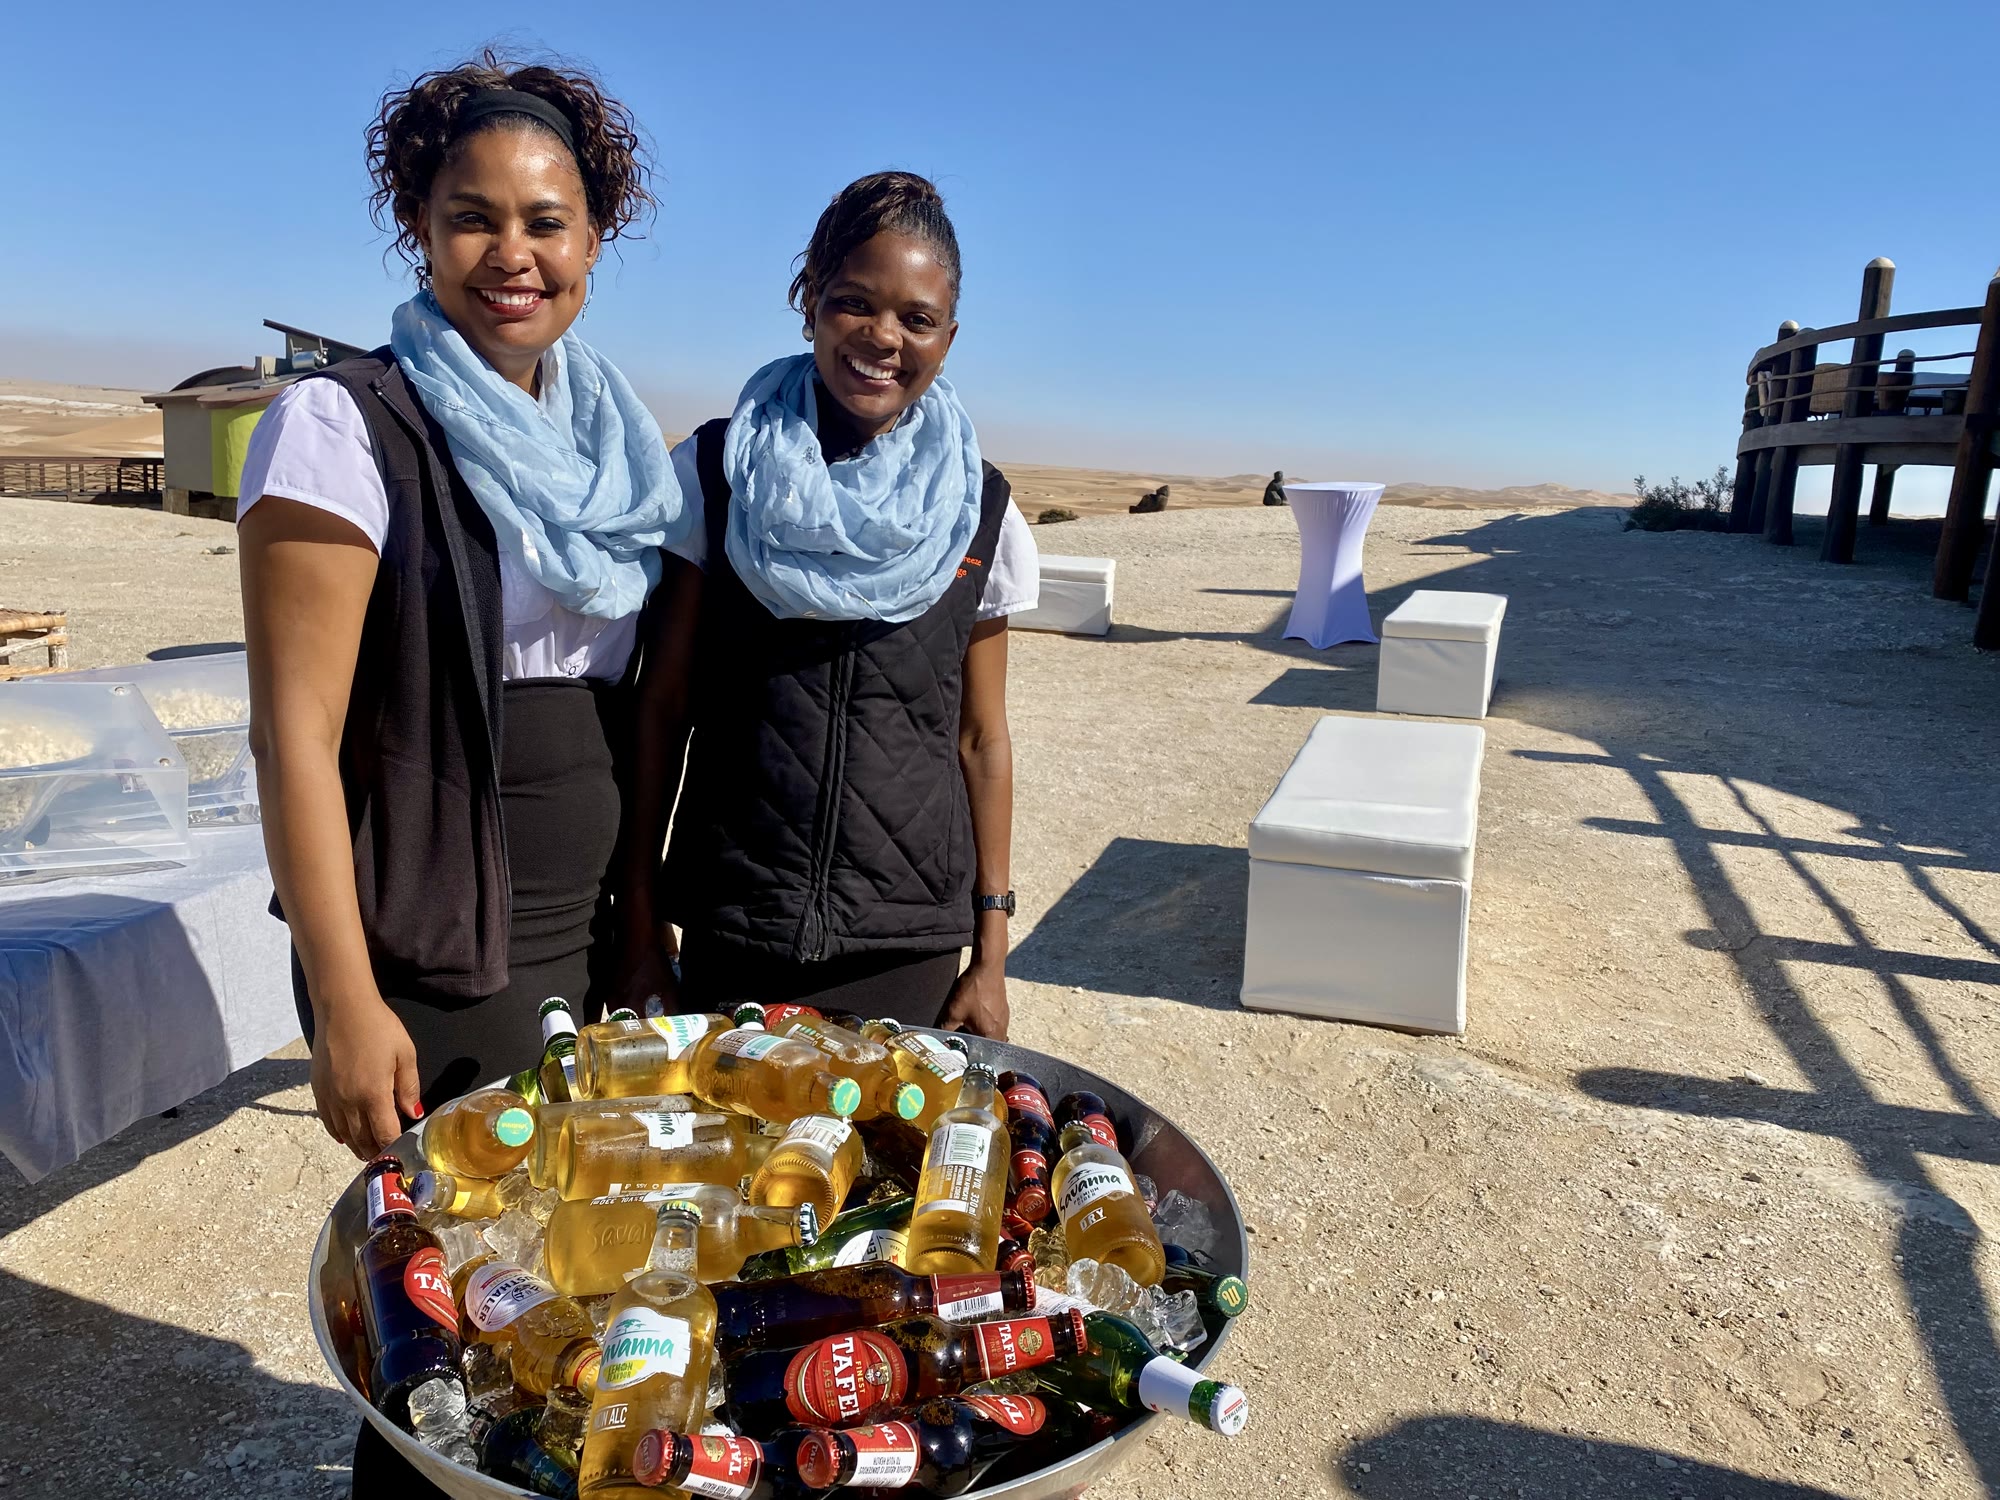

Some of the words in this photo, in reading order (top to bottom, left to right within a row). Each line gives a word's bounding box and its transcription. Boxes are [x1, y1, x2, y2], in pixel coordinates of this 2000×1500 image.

[781, 1006, 801, 1021] TA
[1059, 1173, 1121, 1219] Savanna
[1074, 1187, 1099, 1206] PREMIUM
[1080, 1207, 1107, 1231] DRY
[998, 1324, 1017, 1370] TAFEL
[607, 1371, 632, 1383] FLAVOUR
[608, 1362, 633, 1375] LEMON
[855, 1360, 866, 1394] FINEST
[821, 1360, 836, 1408] LAGER
[609, 1407, 628, 1425] ALC
[1221, 1399, 1248, 1425] CLAUSTHALER
